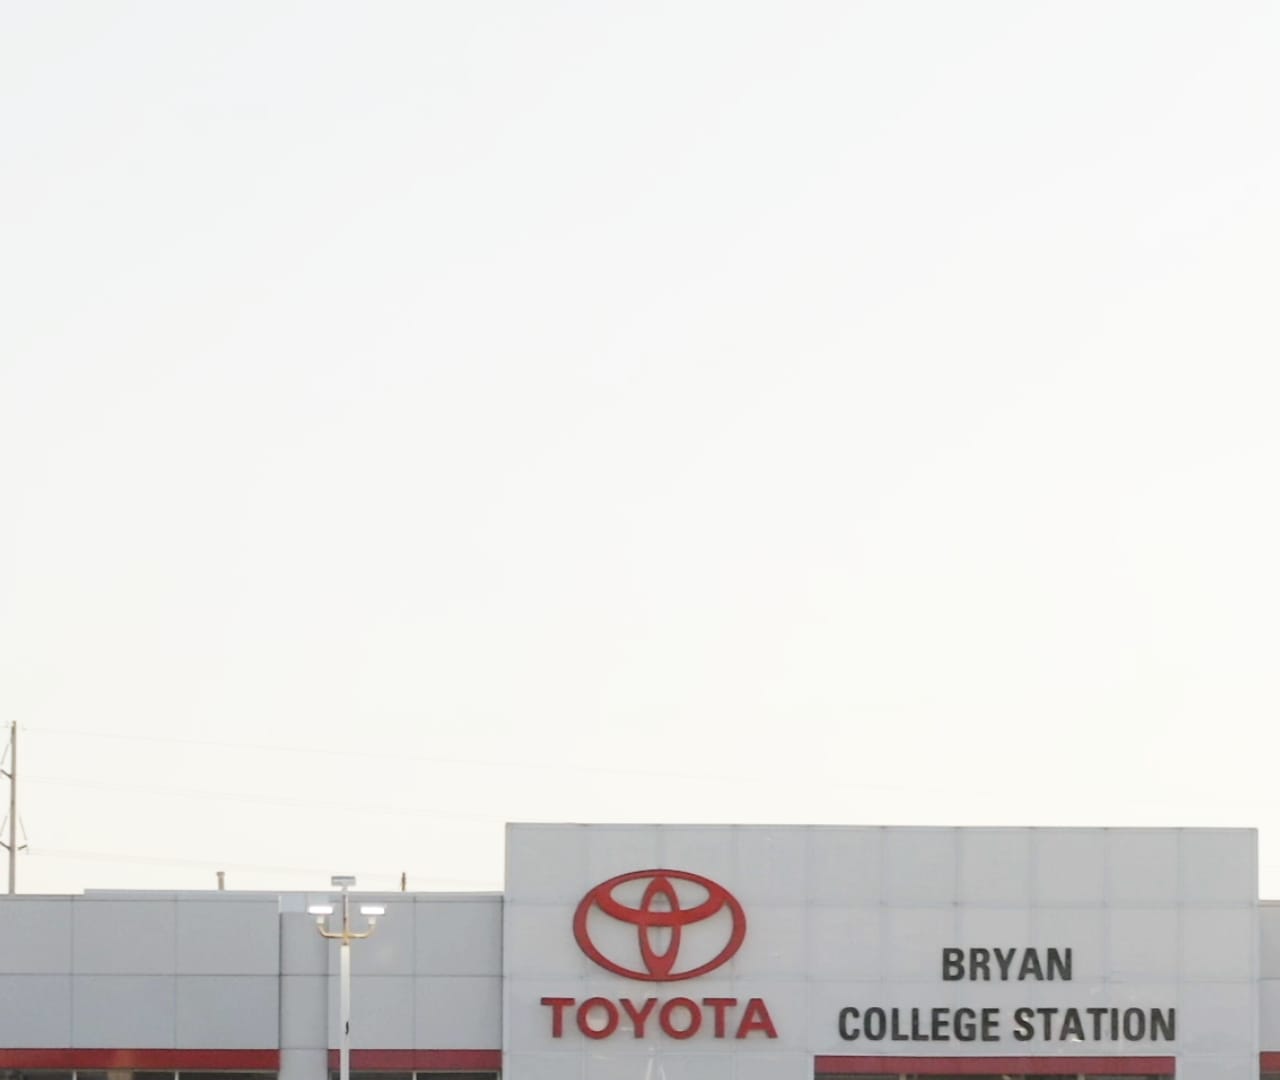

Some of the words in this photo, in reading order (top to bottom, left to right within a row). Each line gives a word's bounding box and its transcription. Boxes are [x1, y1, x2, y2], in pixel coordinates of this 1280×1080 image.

[942, 947, 1073, 982] BRYAN
[542, 997, 778, 1040] TOYOTA
[838, 1006, 1001, 1042] COLLEGE
[1013, 1007, 1176, 1042] STATION
